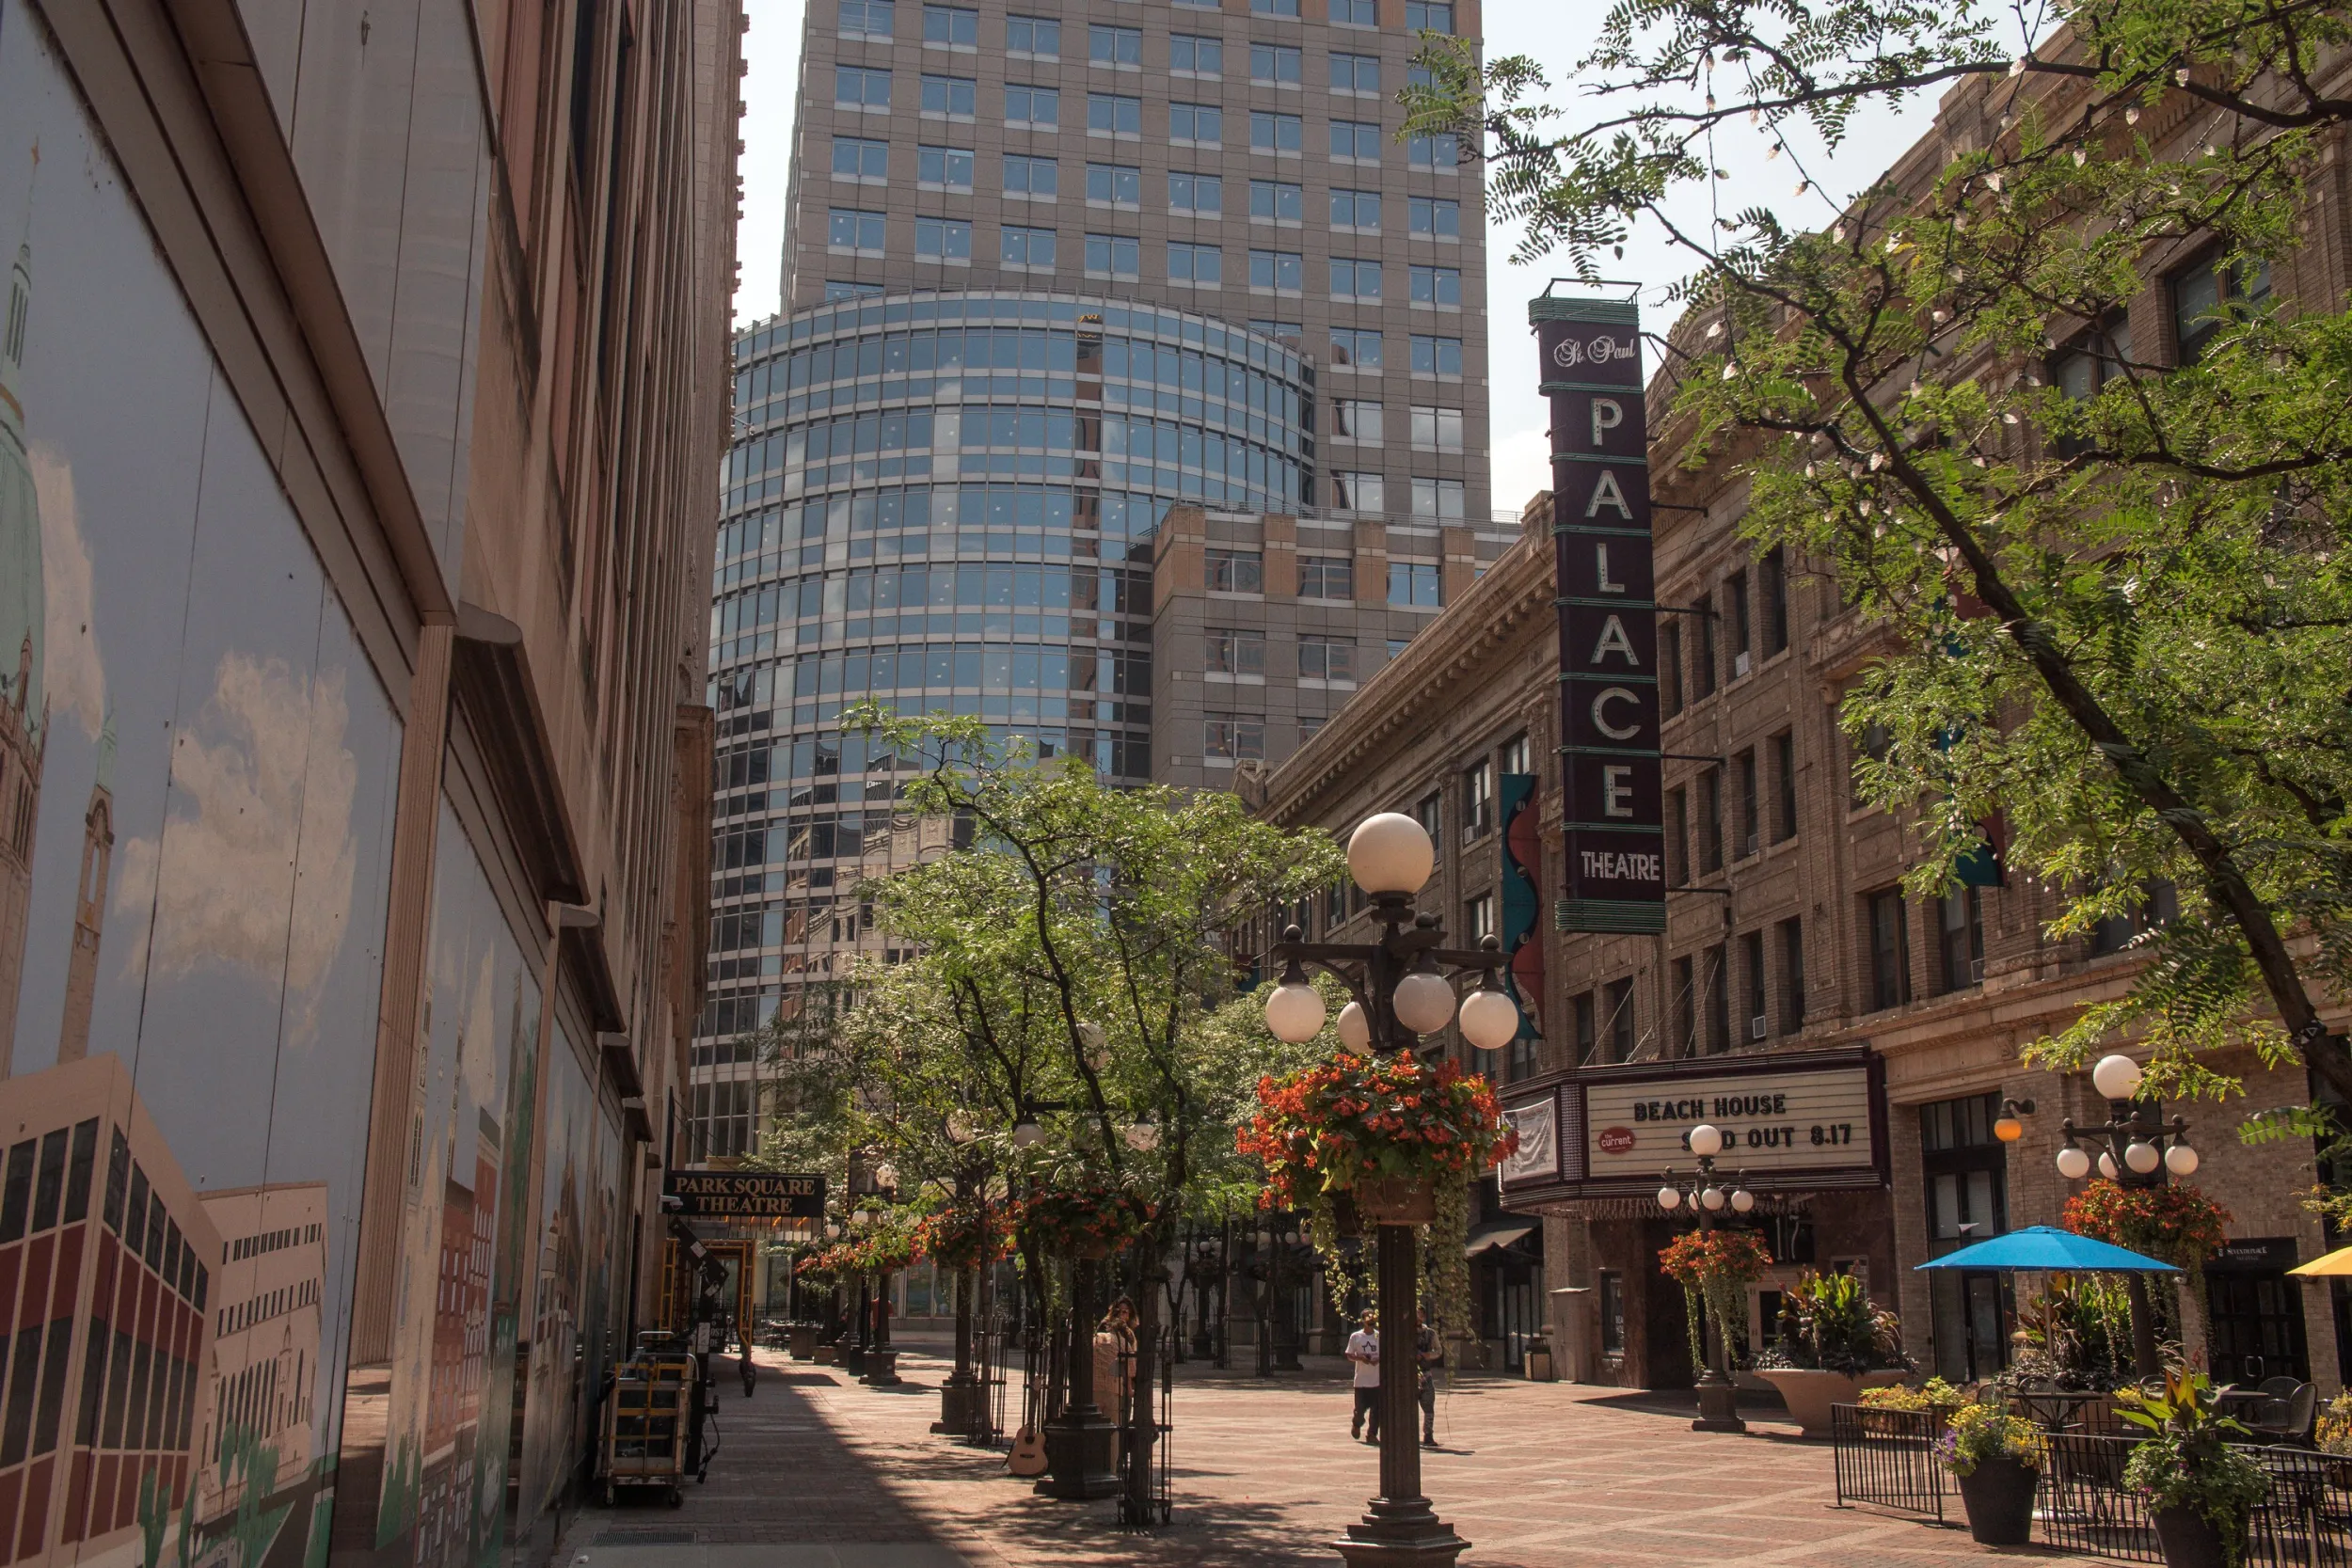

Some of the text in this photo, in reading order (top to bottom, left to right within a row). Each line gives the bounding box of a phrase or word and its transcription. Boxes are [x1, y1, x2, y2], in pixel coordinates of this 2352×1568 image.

[1587, 335, 1635, 364] Paul
[1583, 397, 1642, 818] PALACE
[1581, 850, 1661, 881] THEATRE
[1633, 1093, 1787, 1122] BEACH HOUSE
[1601, 1135, 1632, 1148] current
[1680, 1123, 1851, 1152] SD OUT 8.17
[674, 1177, 816, 1197] PARK SQUARE
[696, 1196, 793, 1214] THEATRE
